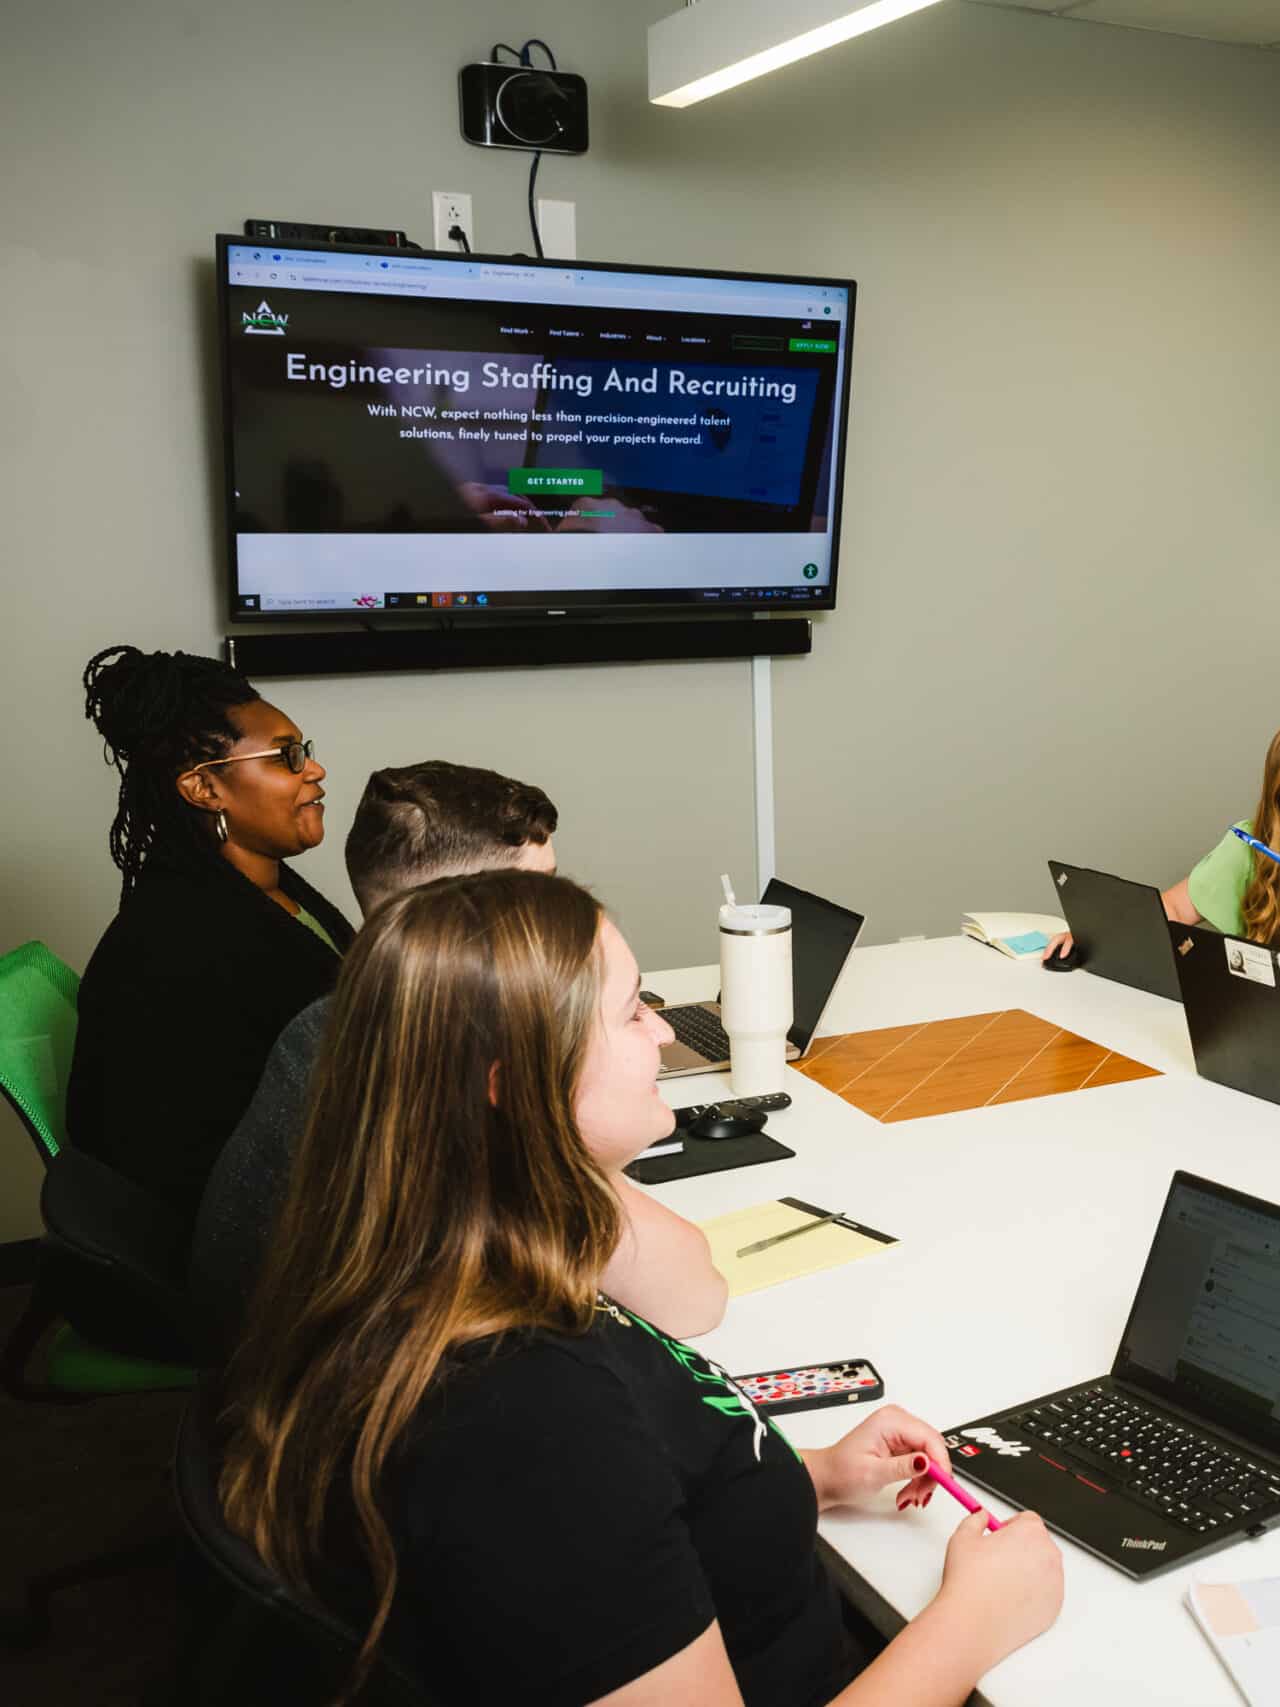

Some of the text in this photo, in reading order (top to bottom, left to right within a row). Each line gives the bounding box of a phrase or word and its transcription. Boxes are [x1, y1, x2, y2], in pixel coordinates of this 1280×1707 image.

[242, 311, 288, 326] NCW
[287, 353, 797, 403] Engineering Staffing And Recruiting
[367, 404, 730, 427] With NCW, expect nothing less than precision-engineered talent
[399, 427, 704, 446] solutions, finely tuned to propel your projects forward.
[527, 477, 584, 486] GET STARTED
[1121, 1536, 1167, 1551] ThinkPad
